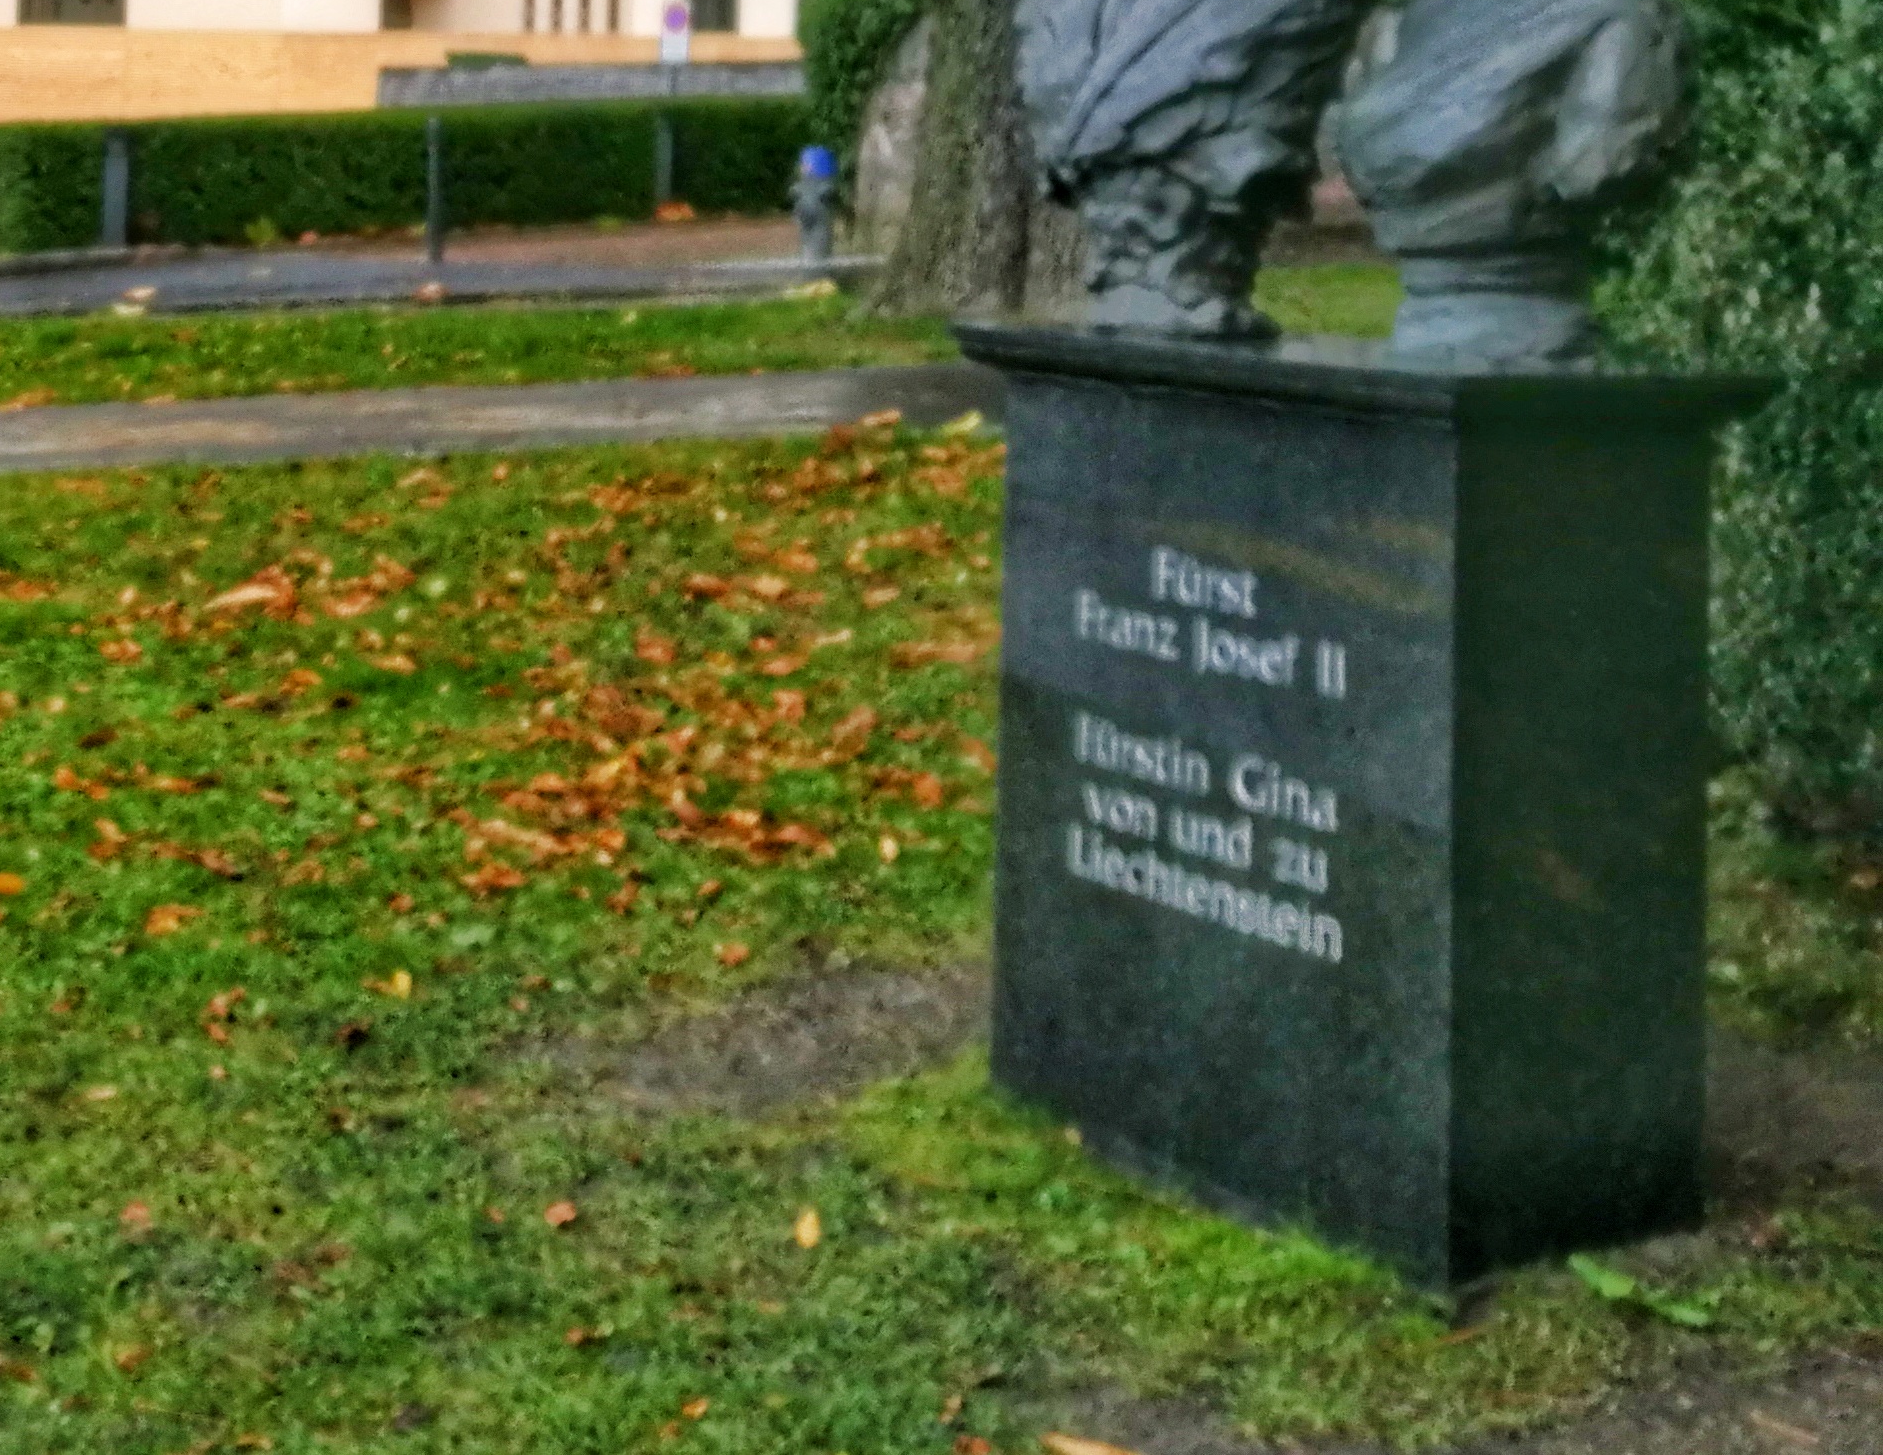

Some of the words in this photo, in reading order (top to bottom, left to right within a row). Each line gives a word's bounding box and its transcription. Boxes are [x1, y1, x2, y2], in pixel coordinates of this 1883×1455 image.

[1152, 546, 1257, 618] Fürst
[1075, 588, 1179, 661] Franz
[1194, 616, 1300, 685] Josef
[1083, 782, 1158, 841] von
[1170, 809, 1253, 870] und
[1273, 838, 1328, 894] zu
[1228, 754, 1338, 832] Gina
[1066, 823, 1343, 963] Liechtenstein
